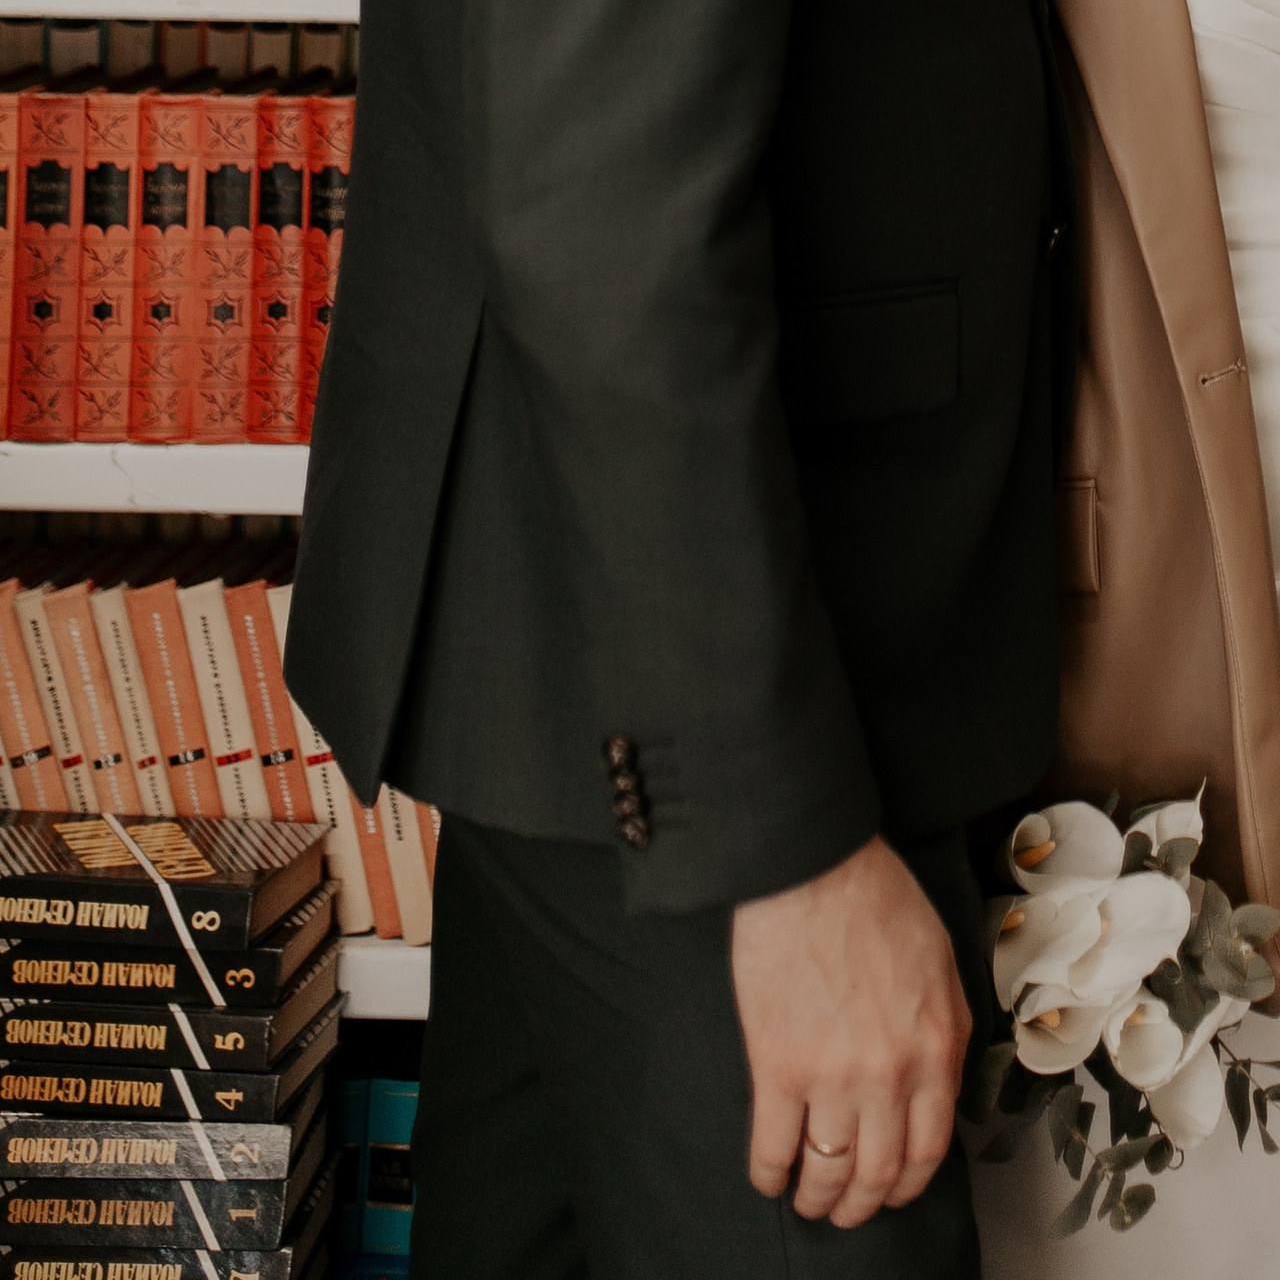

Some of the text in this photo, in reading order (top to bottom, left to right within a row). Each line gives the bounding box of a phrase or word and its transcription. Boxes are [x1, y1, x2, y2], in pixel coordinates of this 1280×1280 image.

[76, 900, 150, 931] ЮЛИАН
[191, 910, 221, 932] 8
[12, 959, 176, 988] ЮЛИАН СЕМЕНОВ
[225, 968, 256, 989] 3
[5, 1019, 168, 1050] ЮЛИАН СЕМЕНОВ
[213, 1032, 245, 1051] 5
[0, 1075, 164, 1108] ЮЛИАН СЕМЕНОВ
[214, 1089, 244, 1111] 4
[6, 1137, 178, 1165] ЮЛИАН СЕМЕНОВ
[230, 1143, 260, 1164] 2
[7, 1199, 175, 1226] ЮЛИАН СЕМЕНОВ
[228, 1208, 259, 1223] 1
[107, 1263, 182, 1280] ЮЛИАН
